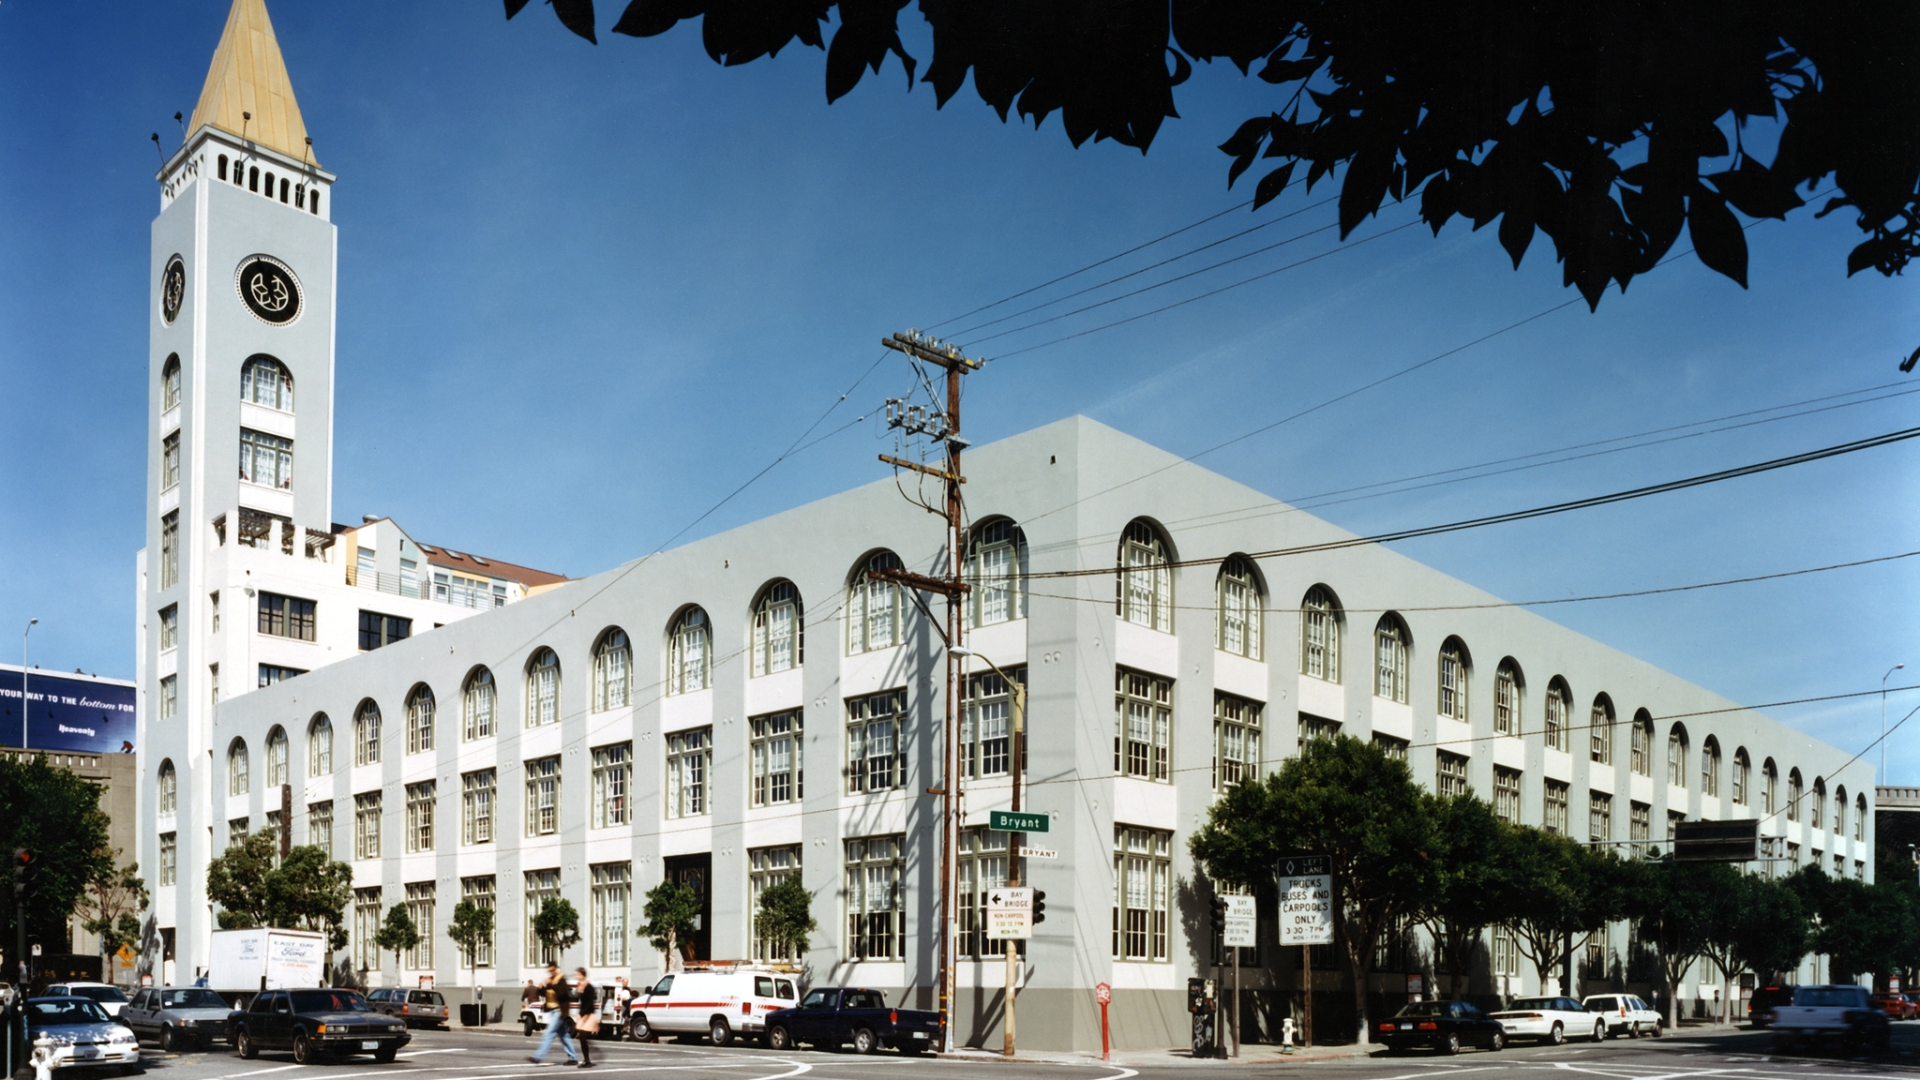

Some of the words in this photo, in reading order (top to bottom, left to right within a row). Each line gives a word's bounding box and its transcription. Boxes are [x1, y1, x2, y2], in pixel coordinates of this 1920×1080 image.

[0, 688, 22, 698] YOUR
[26, 691, 44, 701] WAY
[47, 694, 58, 703] TO
[61, 696, 77, 705] THE
[79, 696, 116, 711] bottom
[118, 703, 134, 712] FOR
[1000, 815, 1040, 828] Bryant
[1022, 848, 1056, 858] BRYANT
[1303, 858, 1323, 867] LEFT
[1303, 866, 1324, 875] LANE
[1289, 878, 1322, 889] TRUCKS
[1281, 890, 1307, 901] BUSES
[1312, 890, 1329, 900] AND
[1282, 902, 1329, 913] CARPOOLS
[1294, 915, 1317, 924] ONLY
[281, 947, 306, 957] Ford
